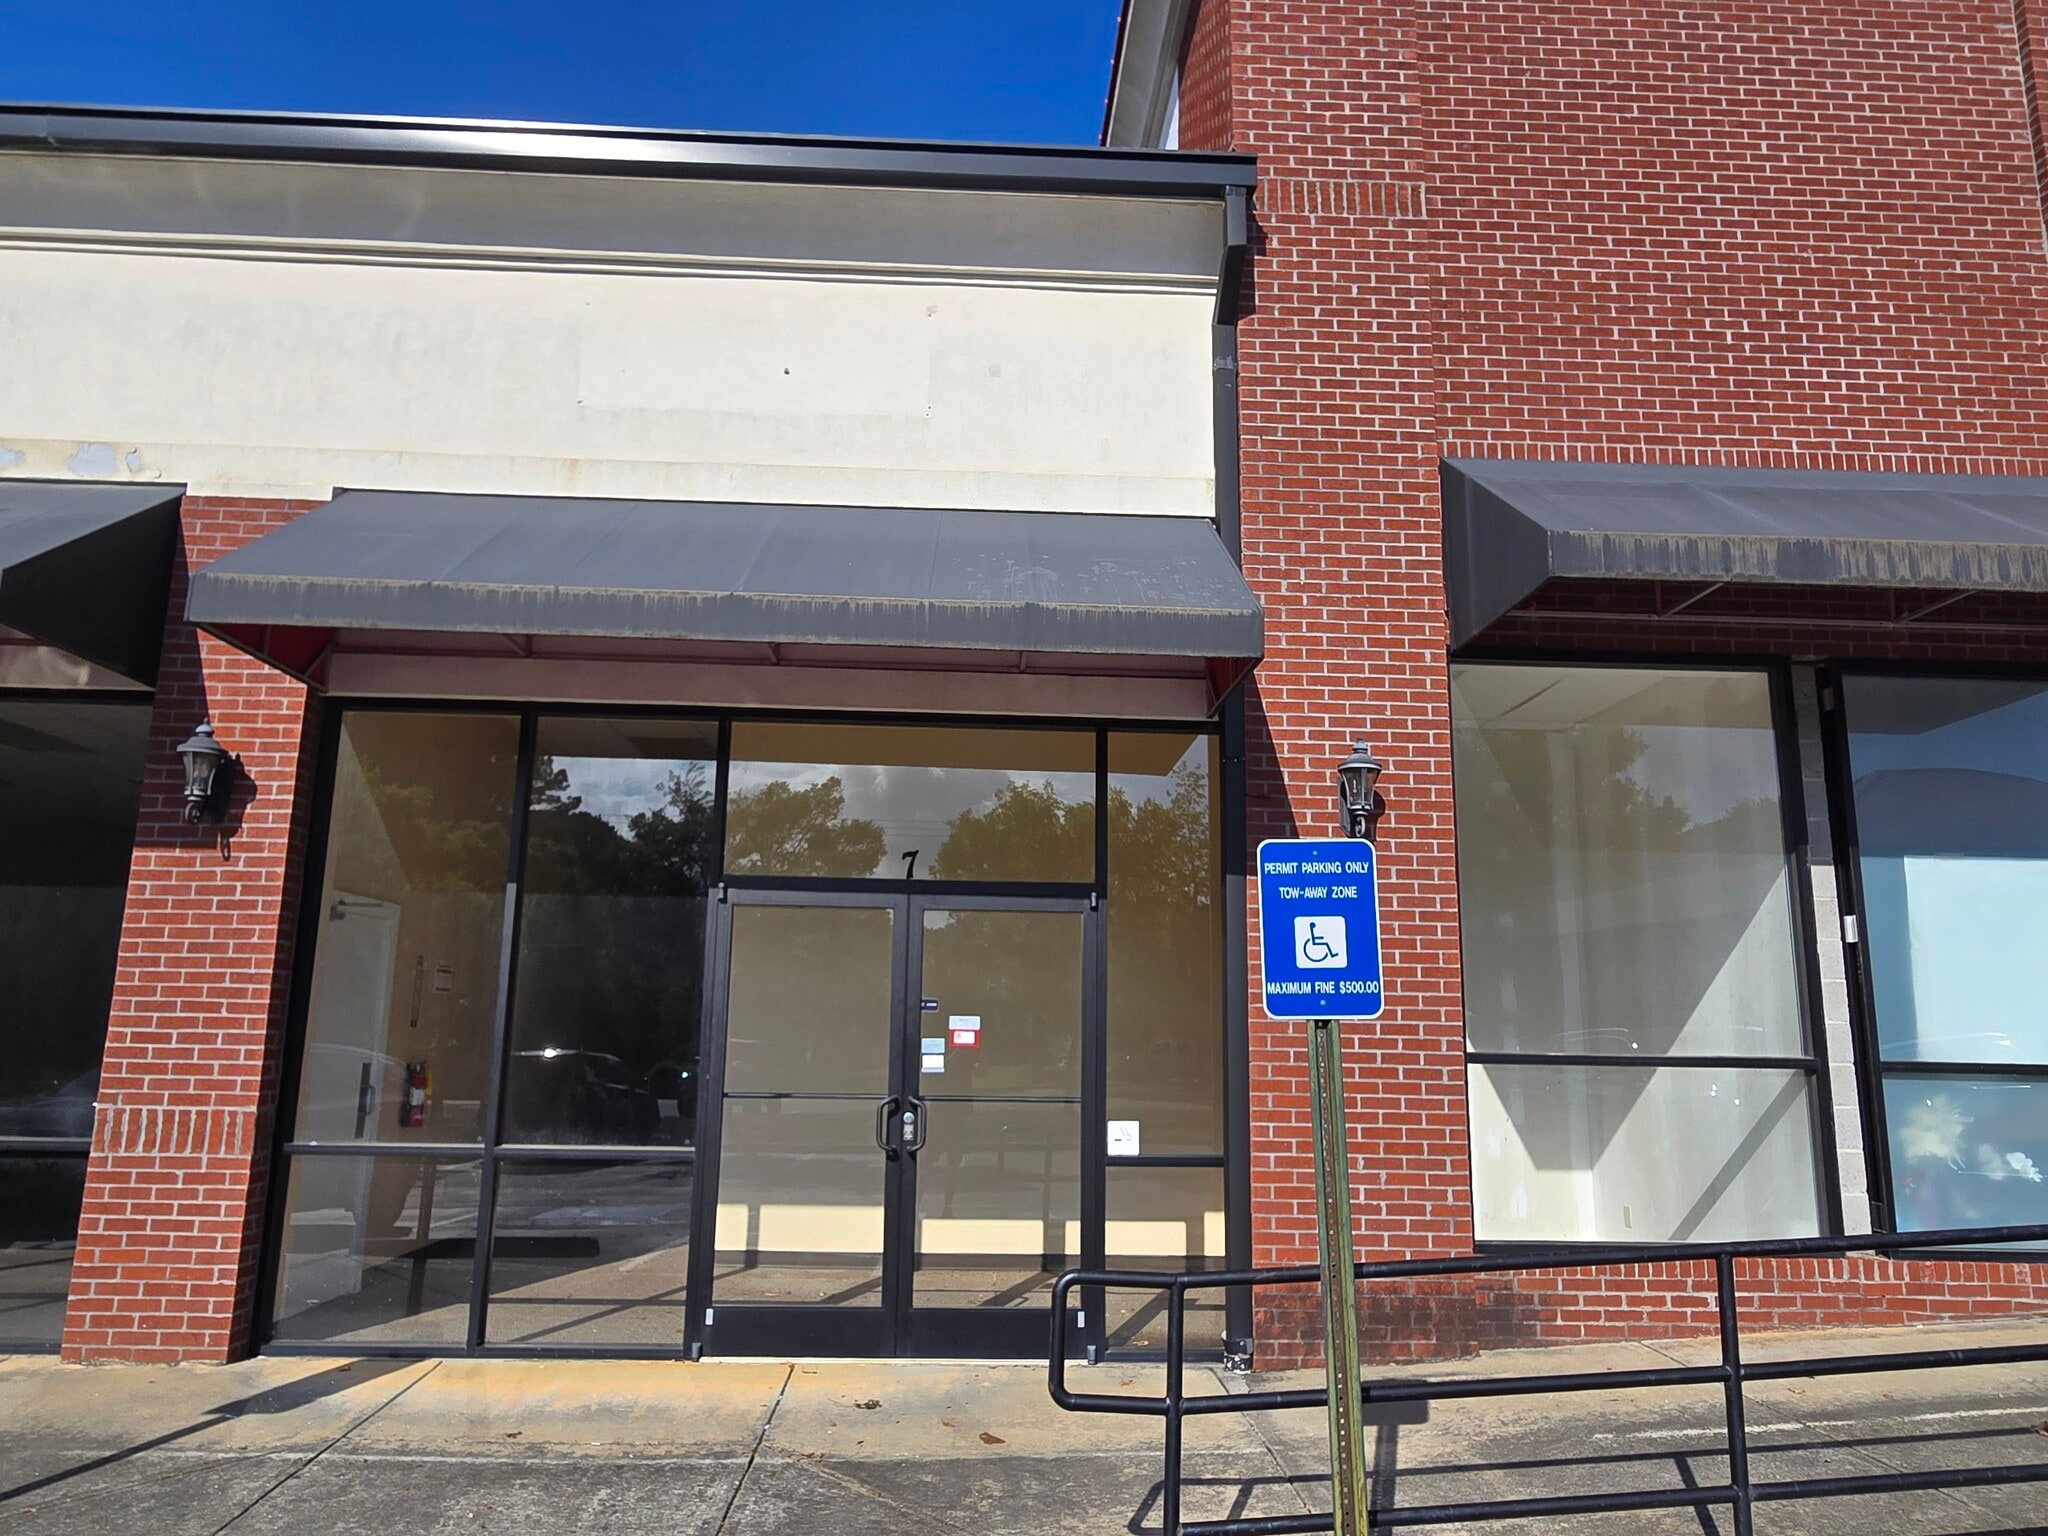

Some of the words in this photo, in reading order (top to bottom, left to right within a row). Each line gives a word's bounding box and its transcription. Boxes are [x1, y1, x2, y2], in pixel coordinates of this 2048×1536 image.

[901, 849, 919, 880] 7
[1264, 862, 1298, 874] PERMIT
[1302, 861, 1342, 874] PARKING
[1345, 861, 1369, 873] ONLY
[1279, 886, 1328, 899] TOW-AWAY
[1331, 886, 1358, 898] ZONE
[1267, 981, 1312, 995] MAXIMUM
[1315, 981, 1336, 994] FINE
[1339, 980, 1380, 995] $500.00
